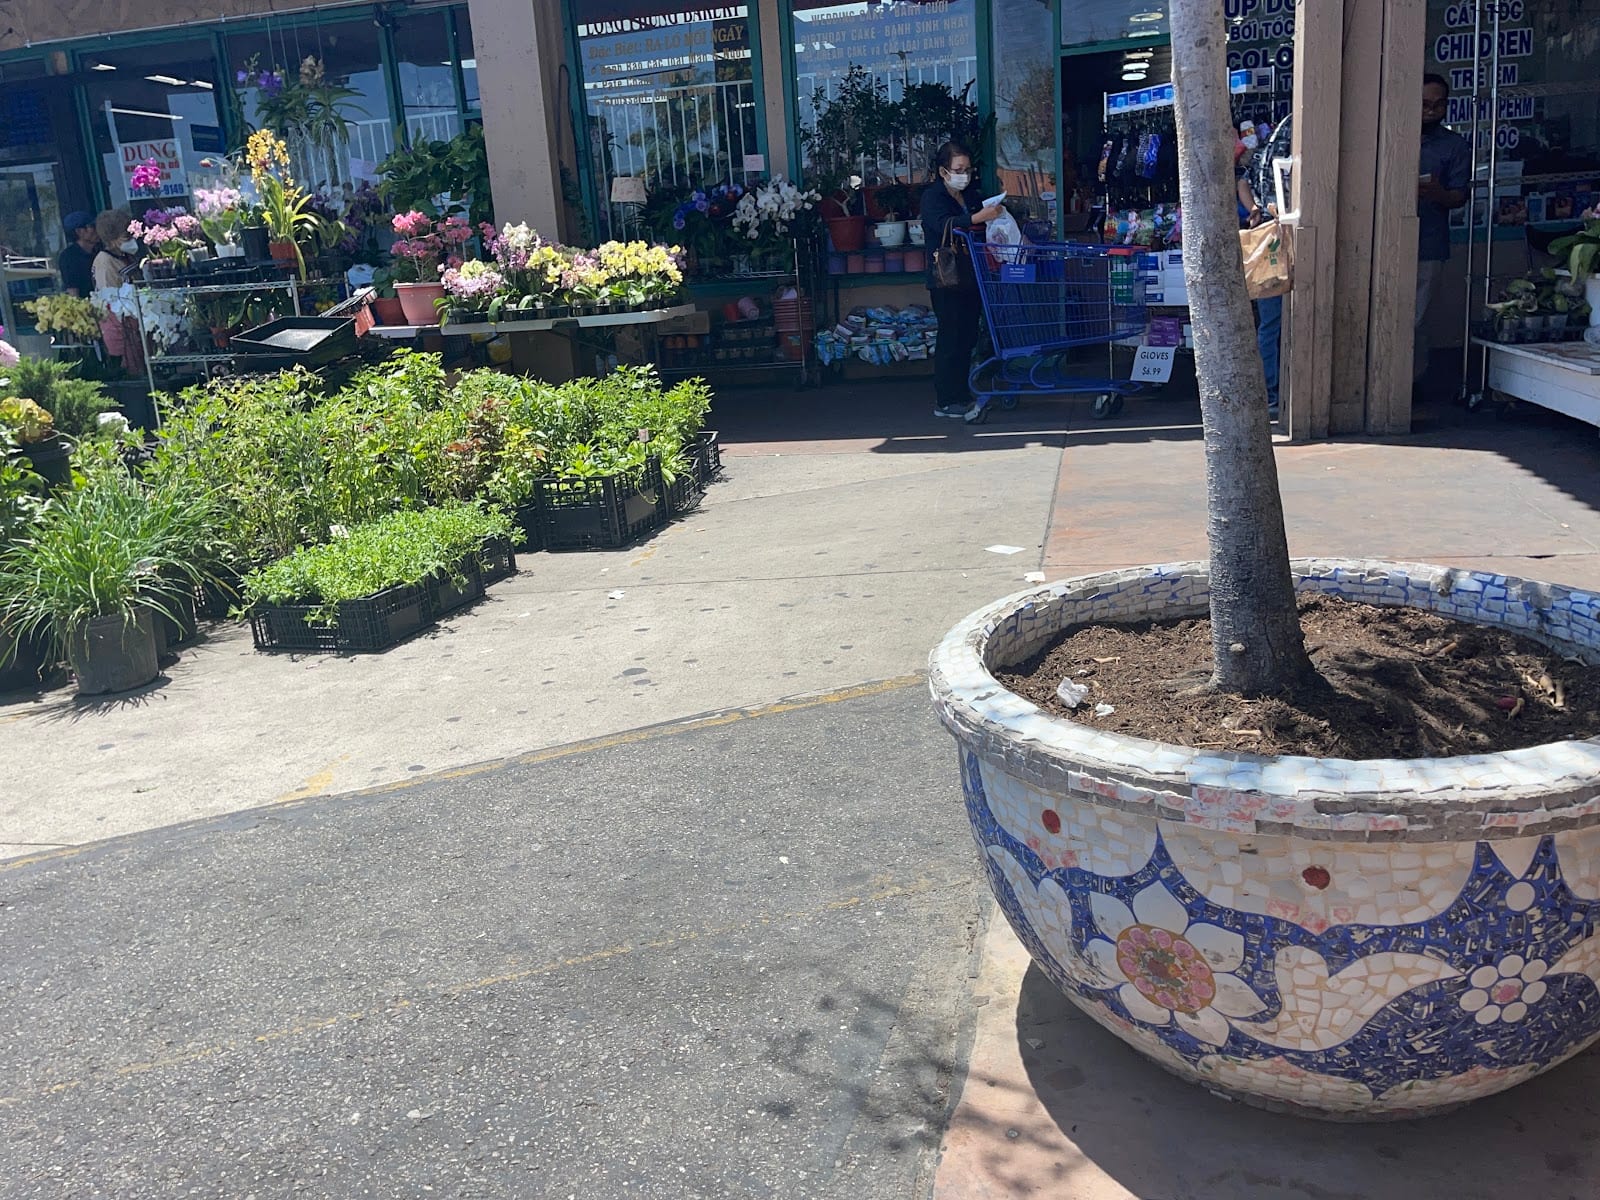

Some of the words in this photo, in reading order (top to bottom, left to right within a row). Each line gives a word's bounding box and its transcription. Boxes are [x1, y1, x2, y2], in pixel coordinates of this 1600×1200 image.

[811, 11, 855, 26] WEDDING
[851, 27, 876, 41] CAKE
[123, 141, 177, 162] DUNG
[1140, 351, 1169, 361] GLOVES
[1142, 366, 1162, 376] $6.99
